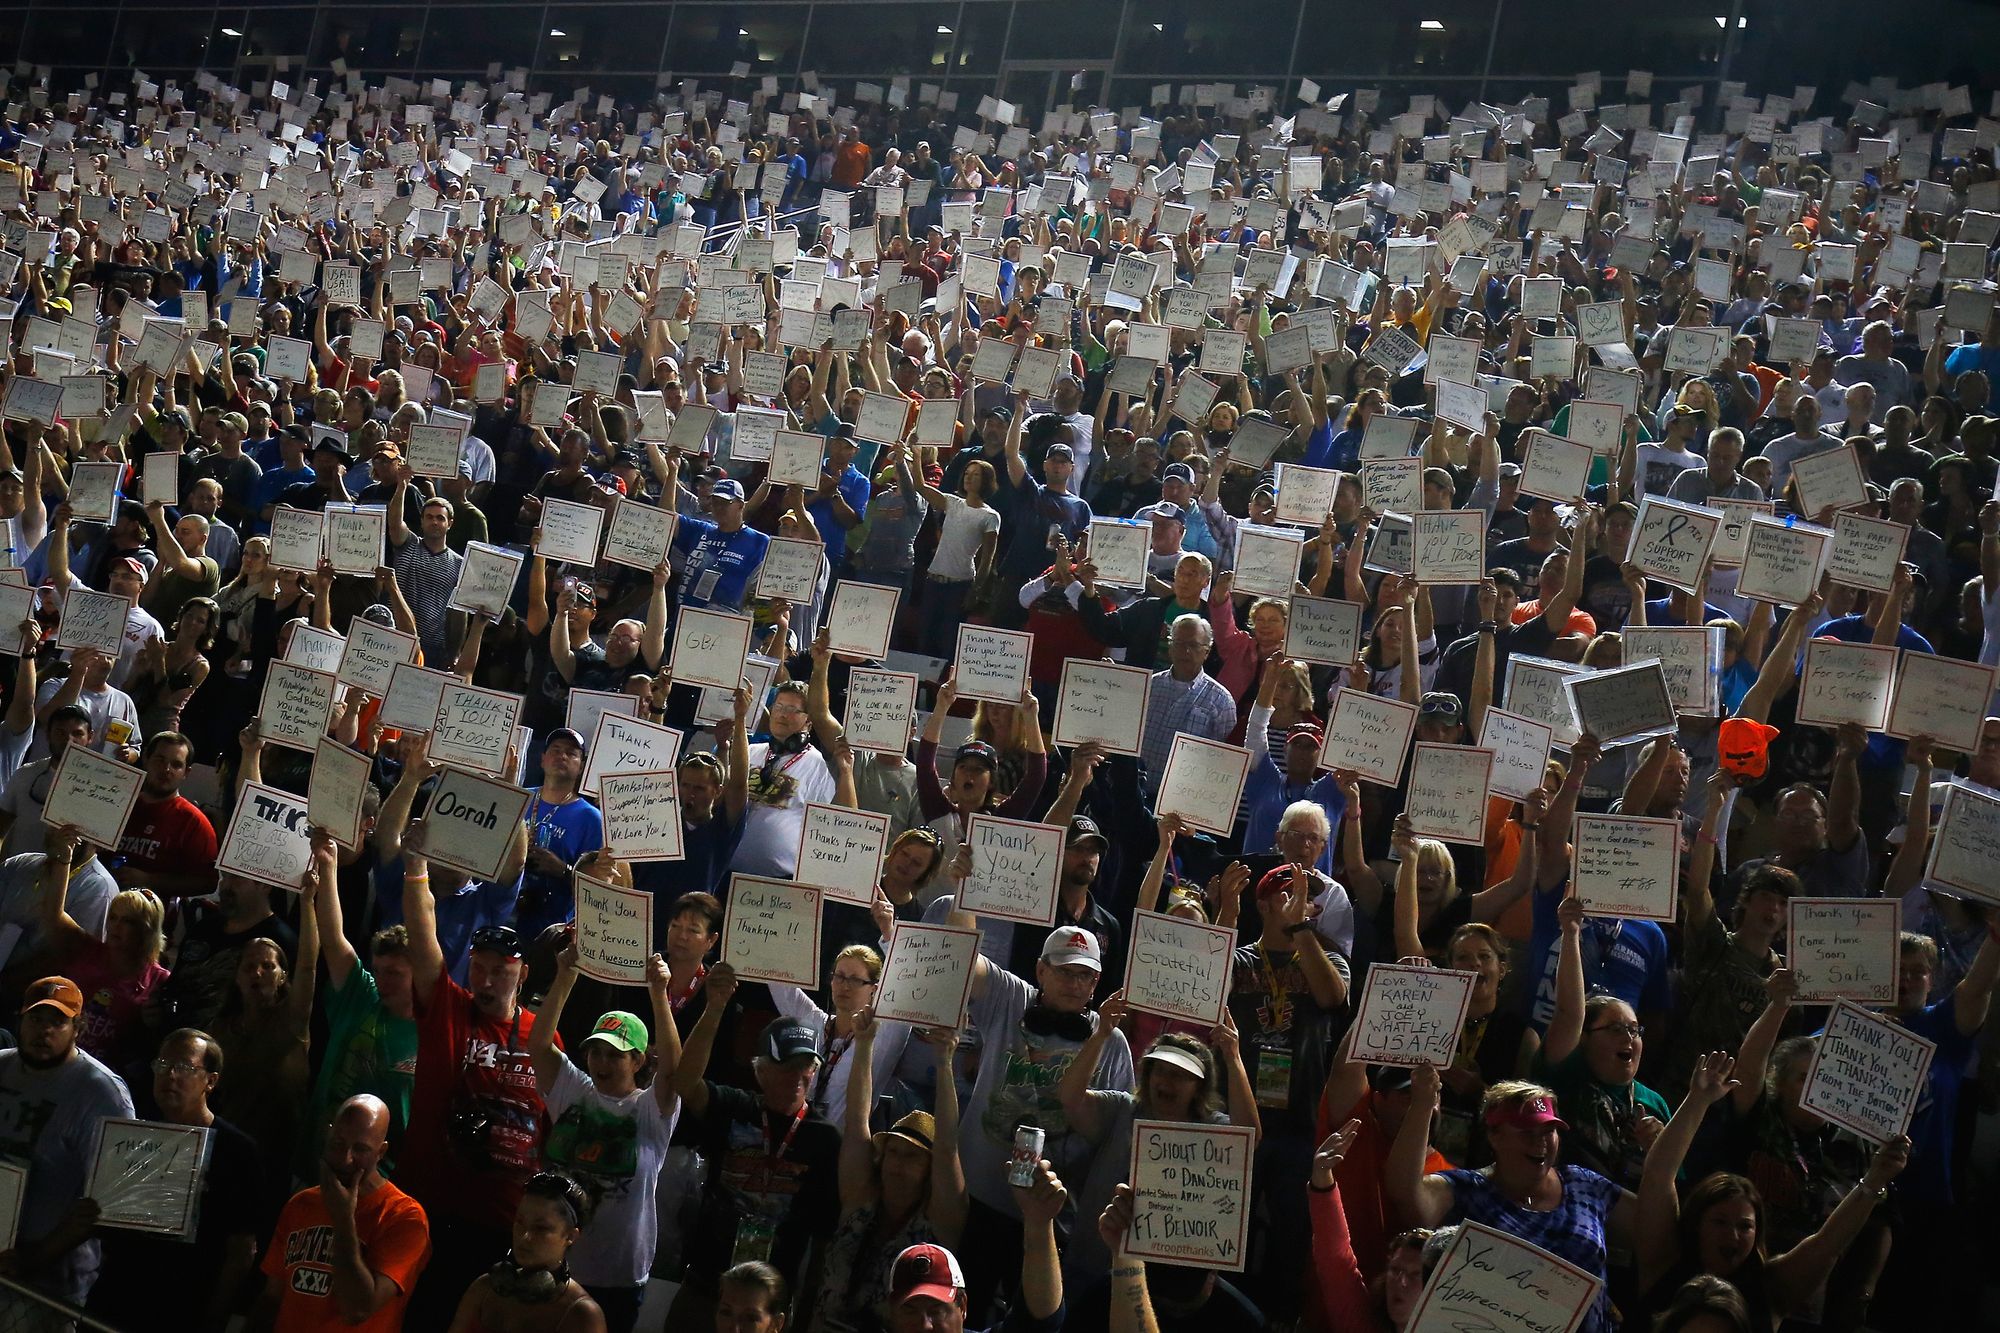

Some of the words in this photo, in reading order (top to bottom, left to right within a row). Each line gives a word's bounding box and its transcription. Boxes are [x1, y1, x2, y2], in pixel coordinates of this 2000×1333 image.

[1774, 144, 1797, 157] YOU
[328, 269, 353, 280] USA!!
[1121, 260, 1149, 272] THANK
[327, 279, 352, 289] USA!!
[1180, 308, 1192, 316] GET
[1387, 328, 1415, 354] DEFEND
[1376, 338, 1409, 364] FREEDOM
[1419, 517, 1460, 534] THANK
[1424, 535, 1449, 550] YOU
[1456, 532, 1475, 545] TO
[1421, 548, 1446, 564] ALL
[1643, 542, 1694, 562] SUPPORT
[1657, 556, 1673, 564] OUR
[1643, 559, 1680, 574] TROOPS
[360, 631, 399, 654] Thanks
[965, 634, 995, 644] Thank
[1000, 638, 1014, 650] you
[305, 653, 325, 668] for
[455, 692, 503, 712] THANK
[435, 707, 448, 733] DAD
[459, 709, 497, 728] YOU!
[501, 705, 515, 735] JEFF
[442, 726, 500, 748] TROOPS
[607, 724, 651, 749] THANK
[1345, 751, 1384, 767] USA
[1414, 783, 1447, 799] Happy
[435, 791, 497, 830] Oorah
[1412, 804, 1460, 824] Birthday
[610, 829, 623, 841] We
[810, 829, 840, 847] Thanks
[844, 838, 855, 849] for
[860, 843, 876, 853] your
[976, 825, 1037, 853] Thank
[622, 848, 664, 856] #troopthanks
[240, 862, 286, 880] #troopthanks
[275, 853, 298, 872] DO
[969, 880, 991, 895] your
[989, 874, 1016, 890] pray
[1024, 876, 1043, 892] for
[582, 887, 608, 908] Thank
[614, 900, 638, 920] You
[740, 890, 764, 907] God
[770, 895, 792, 910] Bless
[980, 902, 1031, 915] #troopthanks
[1595, 903, 1650, 912] #troopthanks
[759, 911, 774, 920] and
[1802, 905, 1842, 920] Thank
[602, 928, 639, 947] Service
[901, 937, 930, 950] Thanks
[1141, 922, 1183, 948] With
[1799, 935, 1826, 947] Come
[599, 949, 644, 966] Awesome
[895, 955, 909, 964] our
[914, 951, 952, 963] freedom
[1136, 943, 1212, 980] Grateful
[1814, 948, 1846, 961] Soon
[743, 965, 795, 979] #troopthanks
[896, 967, 917, 981] God
[924, 966, 946, 977] Bless
[1795, 968, 1815, 984] Be
[1828, 966, 1872, 984] Safe
[1381, 989, 1433, 1003] KAREN
[892, 1009, 940, 1022] #troopthanks
[1381, 1008, 1426, 1020] JOEY
[1368, 1019, 1441, 1035] WHATLEY
[1841, 1011, 1884, 1049] THANK
[1827, 1035, 1866, 1067] THANK
[1836, 1059, 1877, 1089] THANK
[1815, 1068, 1843, 1091] FROM
[1848, 1082, 1865, 1099] THE
[1820, 1091, 1832, 1100] OF
[1835, 1096, 1853, 1113] MY
[1861, 1103, 1896, 1131] HEART
[114, 1139, 164, 1154] THANK
[1149, 1134, 1197, 1163] SHOUT
[1204, 1139, 1233, 1164] OUT
[1162, 1167, 1176, 1180] TO
[1136, 1188, 1156, 1198] United
[1157, 1189, 1178, 1200] States
[1181, 1190, 1205, 1203] ARMY
[1135, 1213, 1158, 1240] FT.
[1165, 1214, 1218, 1239] BELVOIR
[1151, 1241, 1214, 1257] #troopthanks
[1217, 1239, 1236, 1257] VA
[1451, 1236, 1496, 1277] You
[1505, 1269, 1550, 1301] Are
[295, 1268, 330, 1294] XXL
